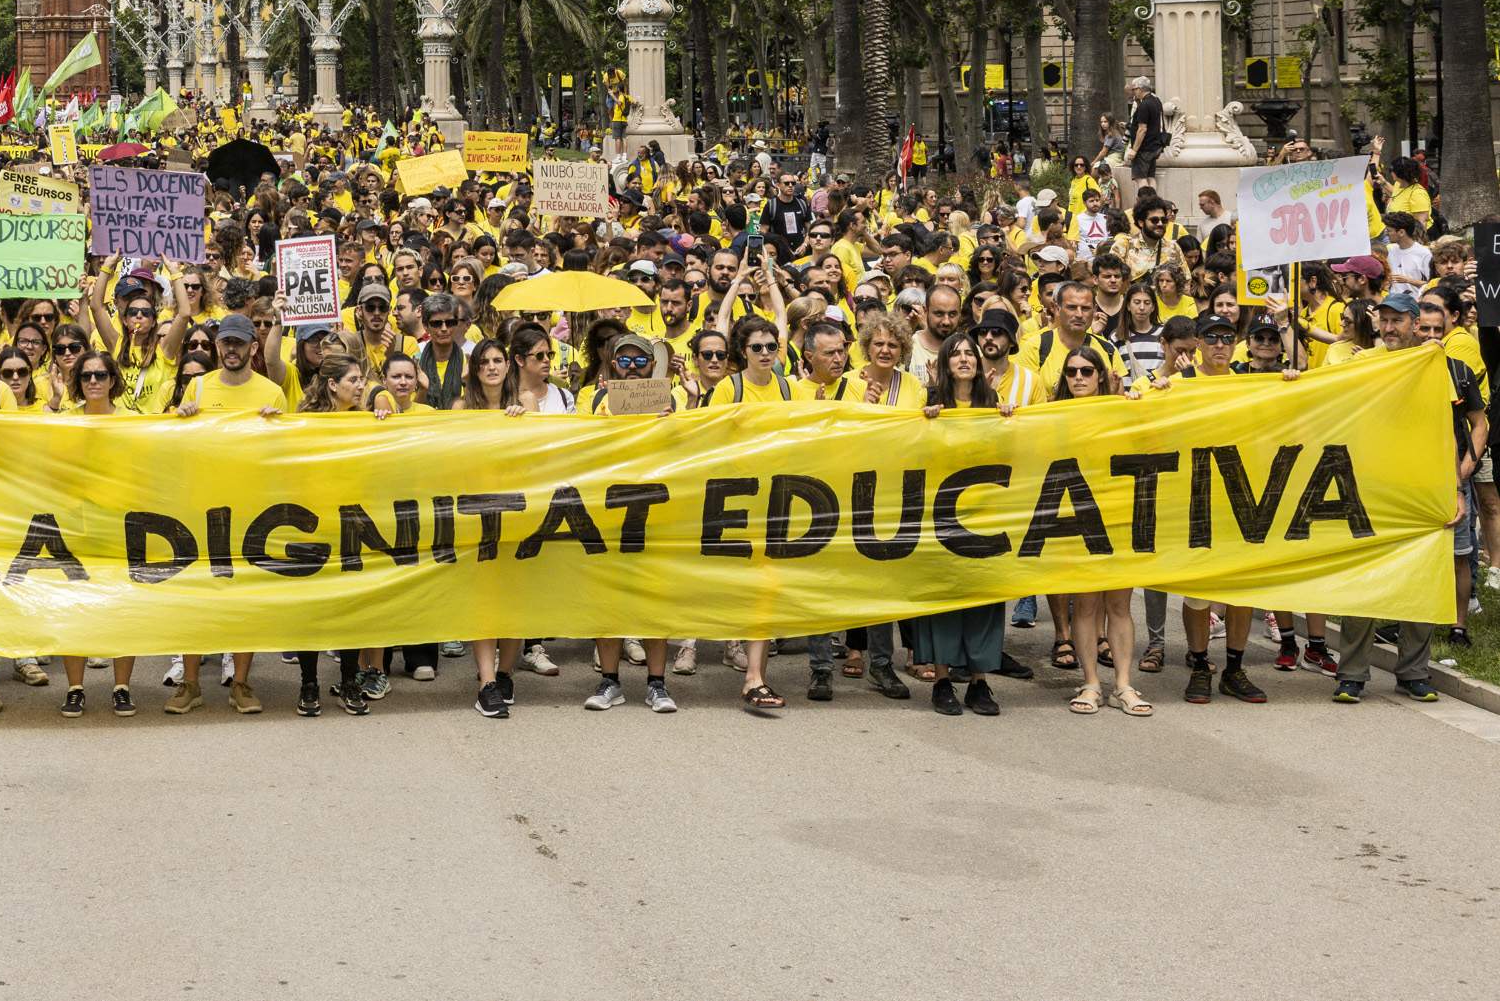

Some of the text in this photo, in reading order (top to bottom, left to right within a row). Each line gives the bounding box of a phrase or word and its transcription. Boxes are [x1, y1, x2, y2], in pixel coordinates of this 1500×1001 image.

[3, 172, 39, 186] SENSE
[93, 167, 205, 197] ELS DOCENTS
[542, 181, 572, 191] DEMANA
[600, 184, 607, 194] A
[14, 184, 73, 201] RECURSOS
[551, 192, 597, 201] LA CLASSE
[96, 194, 179, 213] LLUITANT
[538, 200, 604, 213] TREBALLADORA
[94, 211, 205, 231] TAMBÉ ESTEM
[1269, 198, 1350, 246] JA!!!
[108, 228, 204, 261] EDUCANT
[301, 259, 329, 269] SENSE
[285, 269, 330, 296] PAE
[295, 296, 305, 304] NO
[287, 303, 334, 315] INCLUSIVA
[124, 482, 670, 585] DIGNITAT
[699, 443, 1376, 561] EDUCATIVA
